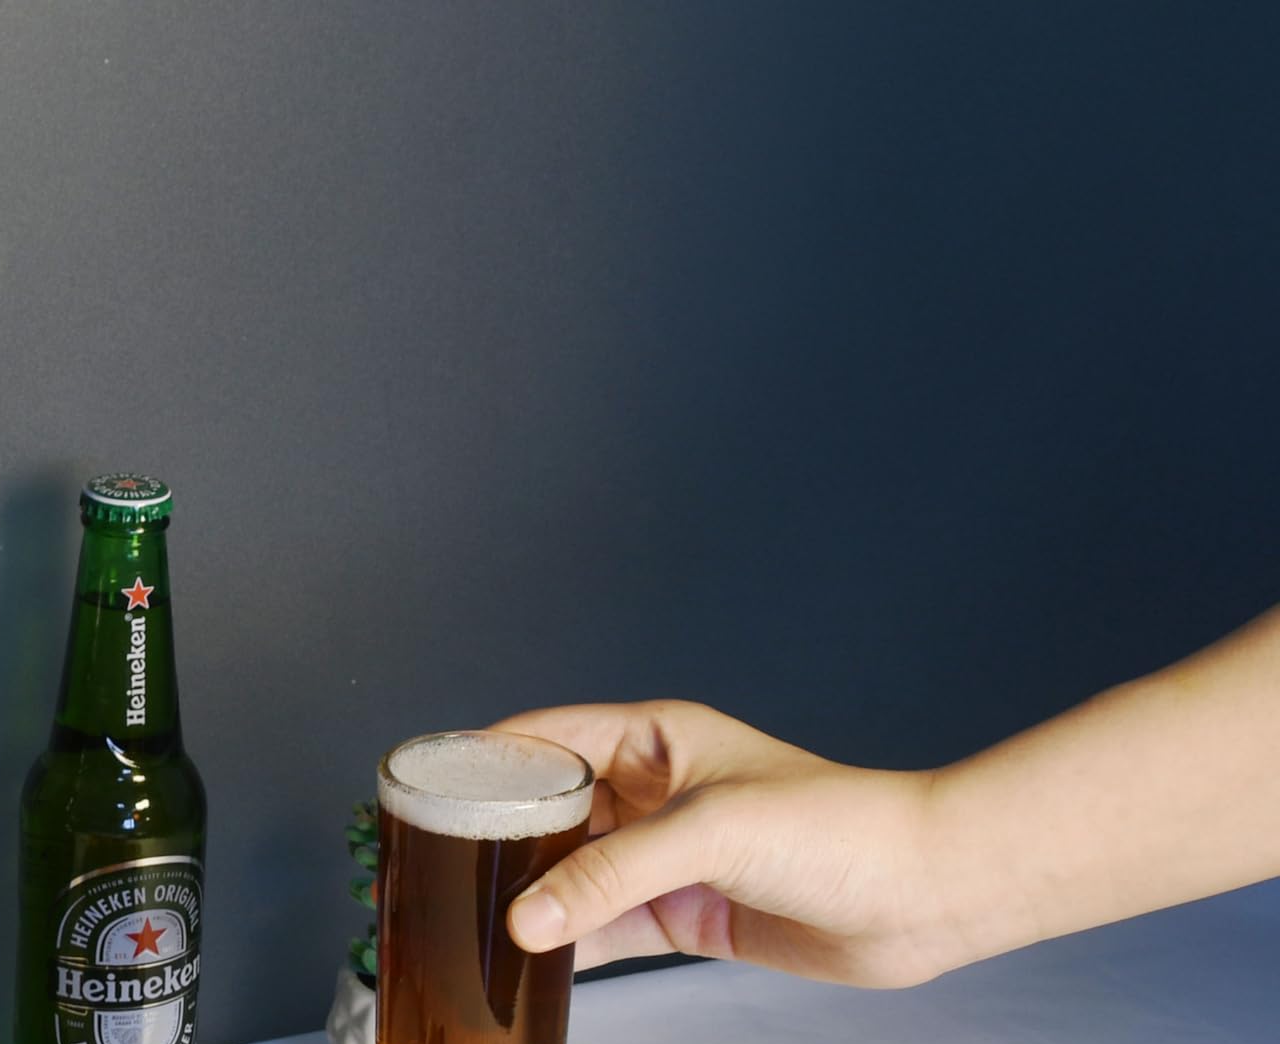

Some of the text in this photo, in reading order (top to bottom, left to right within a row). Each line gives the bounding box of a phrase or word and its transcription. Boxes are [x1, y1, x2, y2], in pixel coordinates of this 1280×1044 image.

[126, 616, 145, 727] Heineken
[88, 879, 123, 896] PREMIUM
[70, 887, 146, 949] HEINEKEN
[154, 885, 200, 933] ORIGINAL
[57, 954, 200, 1003] Heineken
